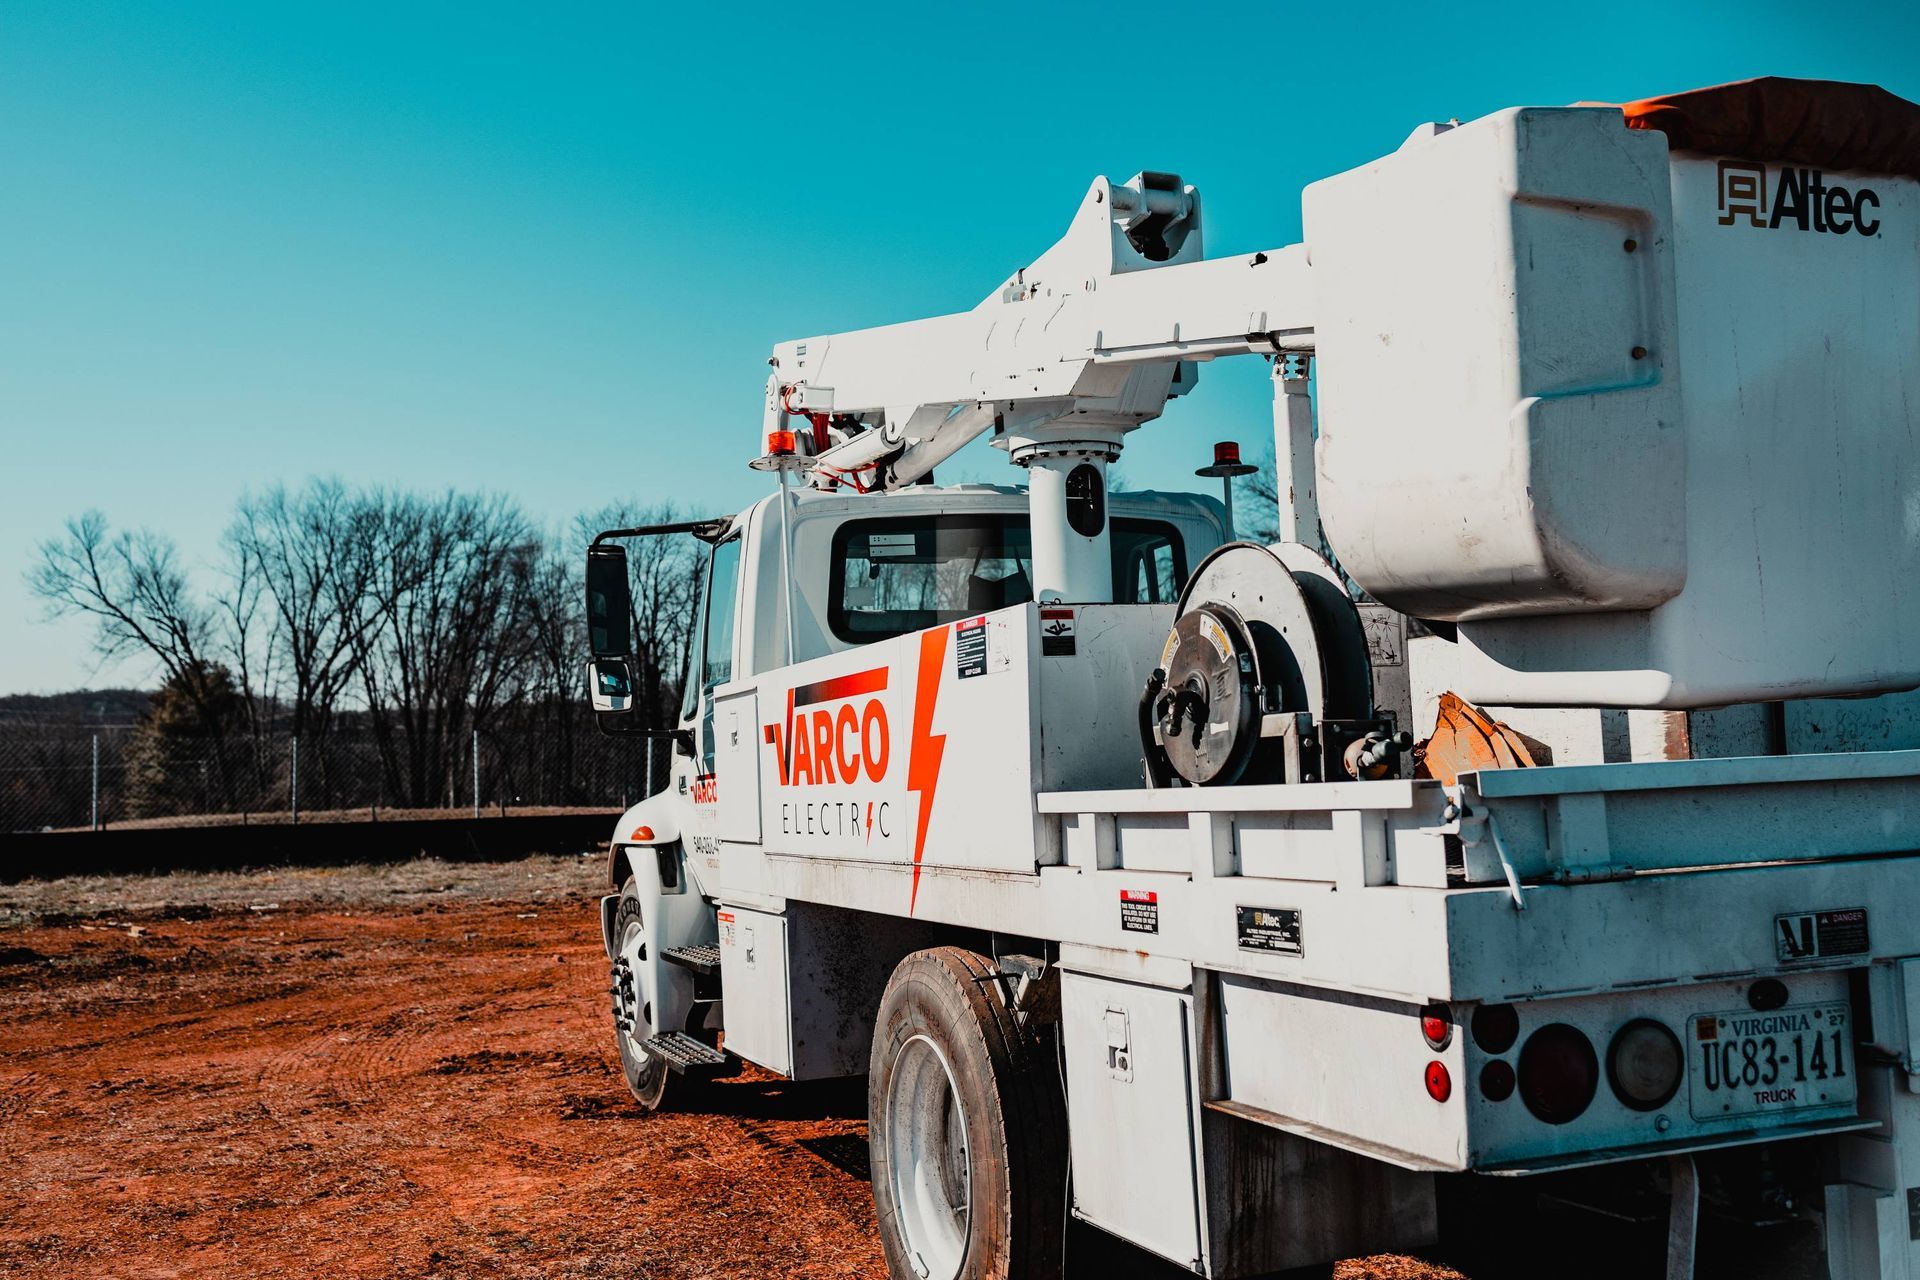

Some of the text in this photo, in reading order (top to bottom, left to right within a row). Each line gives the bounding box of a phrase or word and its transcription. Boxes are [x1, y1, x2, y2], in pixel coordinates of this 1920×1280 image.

[1769, 167, 1881, 237] Altec
[764, 687, 890, 786] VARCO
[690, 777, 718, 804] VARCO
[1127, 890, 1150, 900] WARNING
[1262, 912, 1280, 927] Altec
[1832, 912, 1864, 922] DANGER
[1731, 1013, 1811, 1037] VIRGINIA
[1829, 1014, 1845, 1026] 27
[1700, 1028, 1846, 1092] UC83-141
[1753, 1088, 1797, 1104] TRUCK
